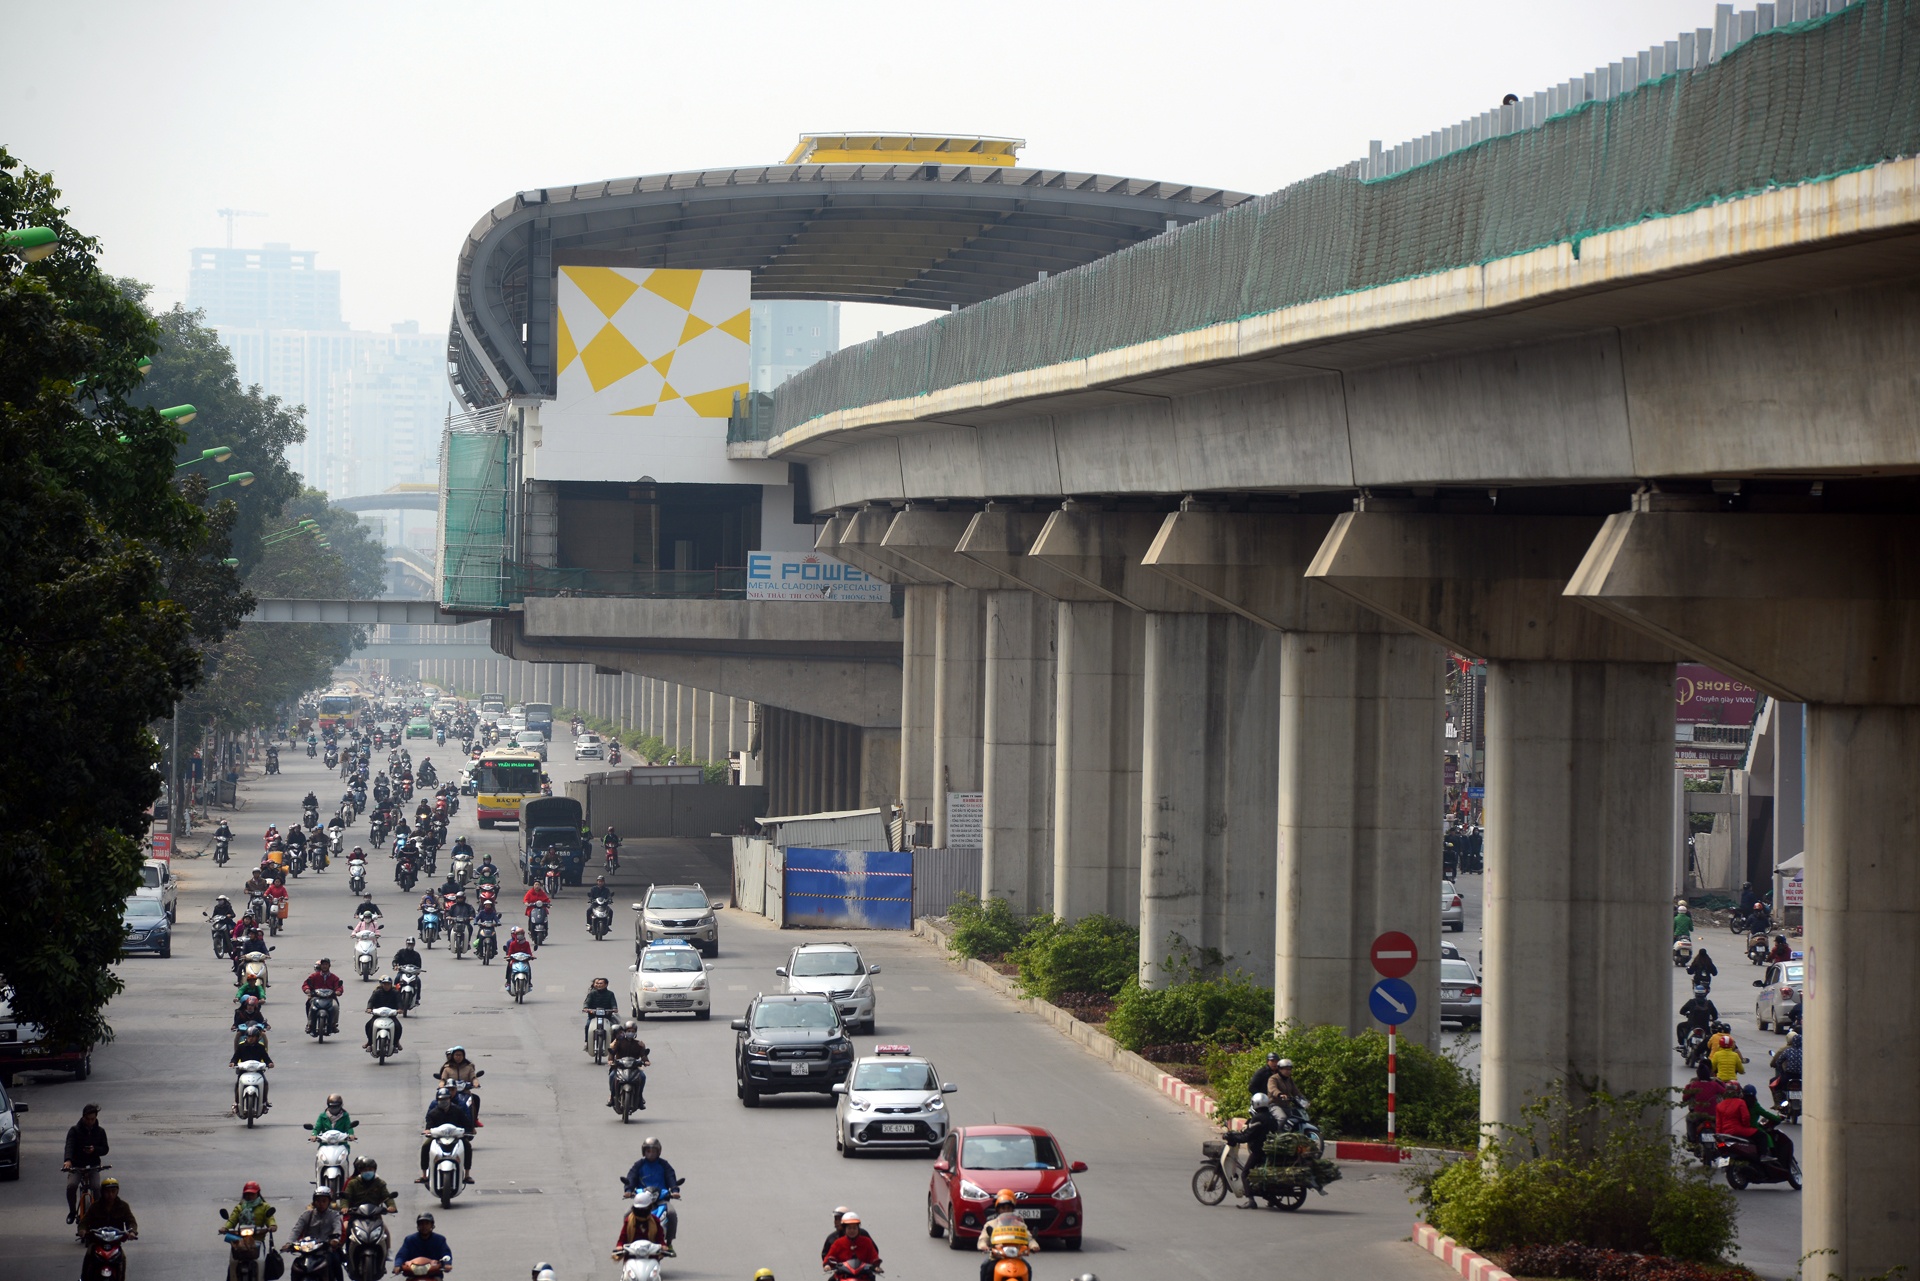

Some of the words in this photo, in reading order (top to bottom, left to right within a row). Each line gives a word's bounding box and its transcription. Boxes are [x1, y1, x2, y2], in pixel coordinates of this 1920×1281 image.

[749, 555, 772, 579] E
[782, 563, 869, 581] POWE
[749, 582, 779, 590] METAL
[832, 584, 882, 592] SPECIALIST
[1696, 681, 1730, 691] SHOE
[1732, 681, 1755, 692] GA
[1696, 695, 1719, 704] Chuyên
